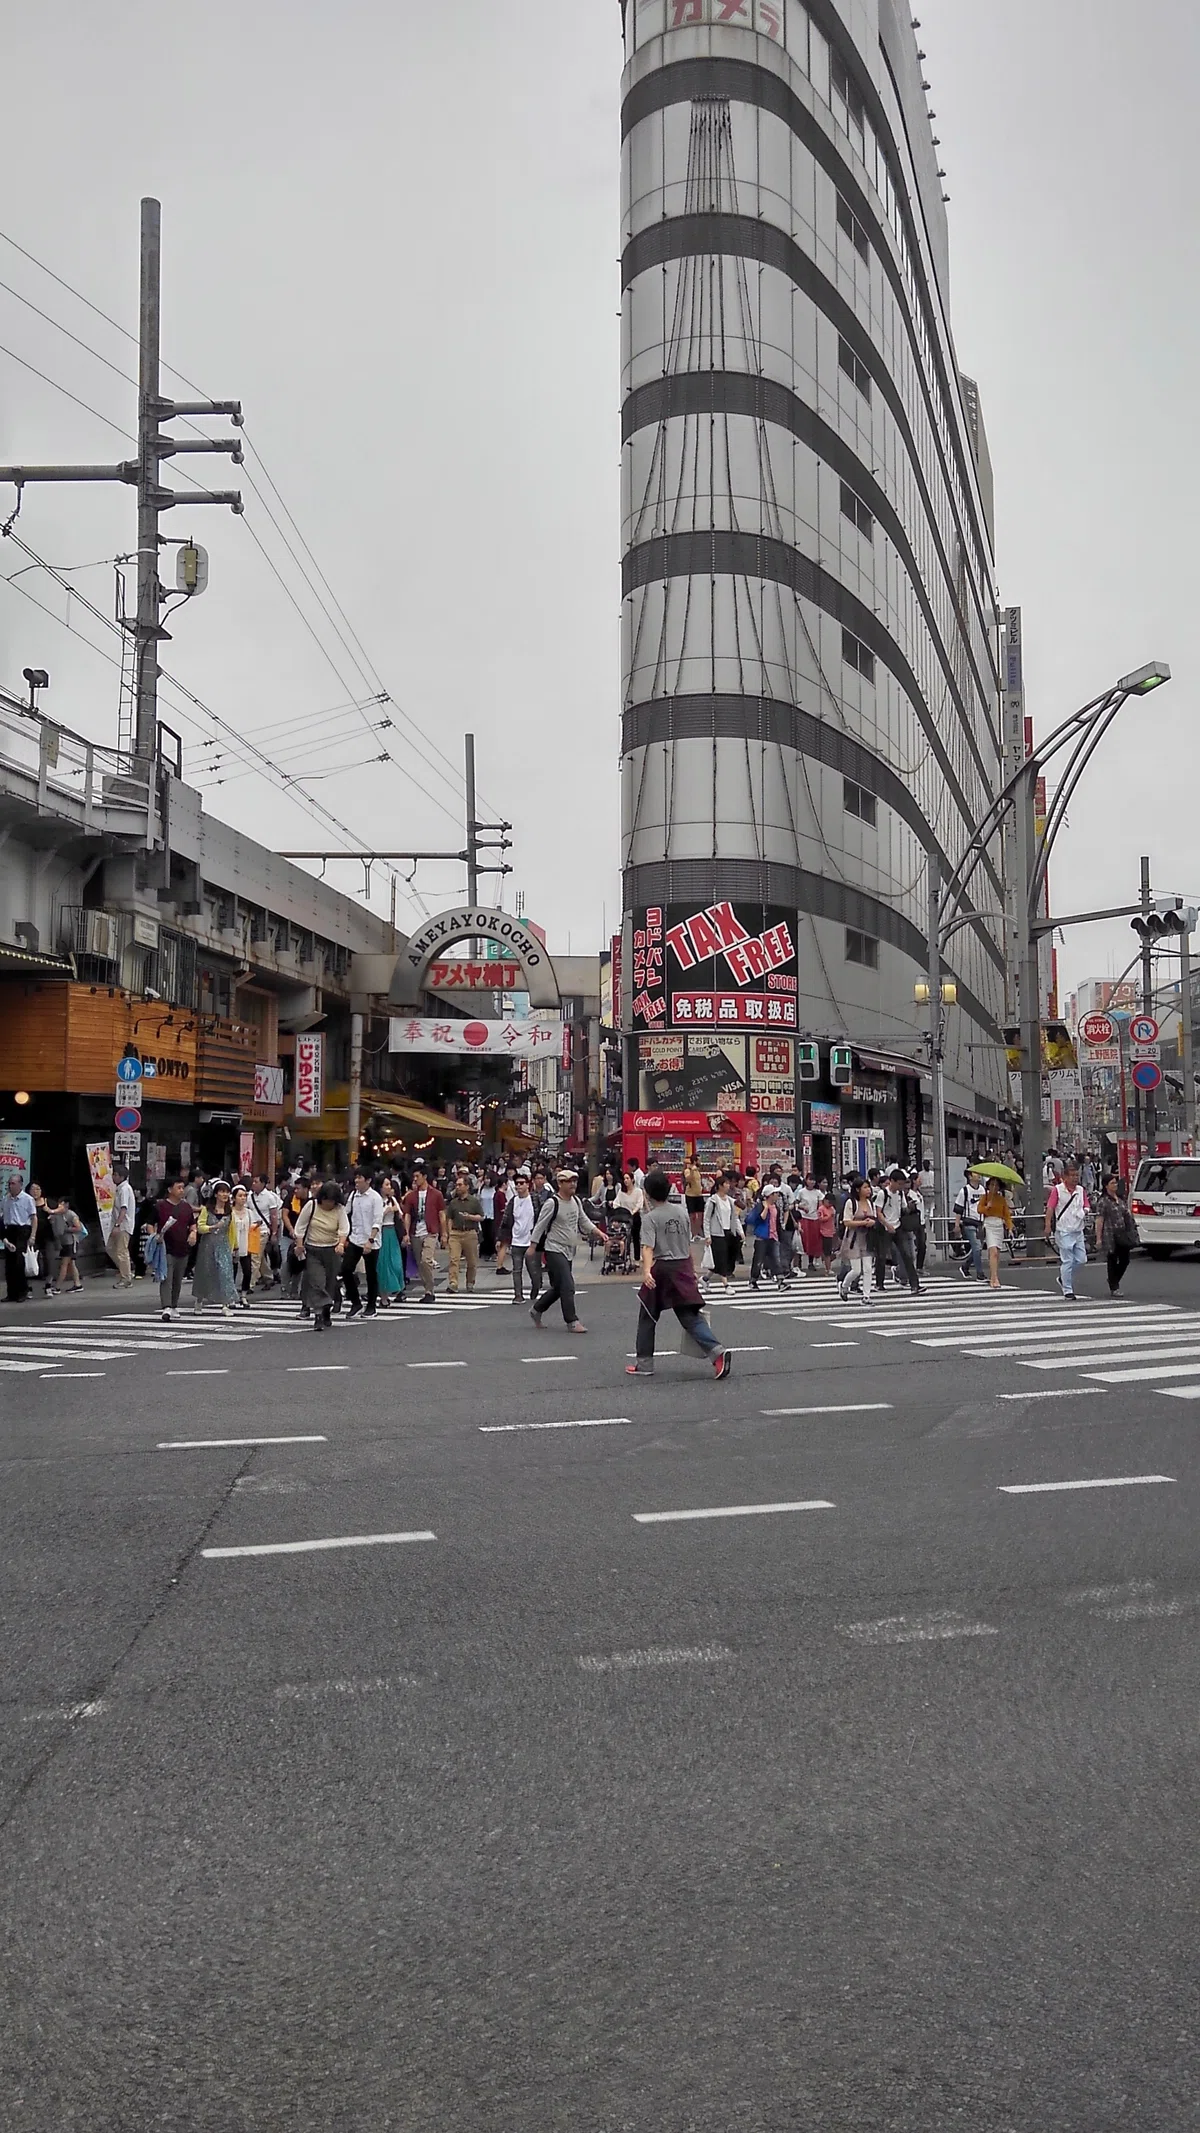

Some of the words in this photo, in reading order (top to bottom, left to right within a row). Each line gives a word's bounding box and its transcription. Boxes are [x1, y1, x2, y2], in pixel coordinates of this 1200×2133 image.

[408, 914, 540, 967] AMEYAYOKOCHO
[646, 907, 662, 988] ヨドバシ
[666, 901, 751, 971] TAX
[723, 920, 796, 987] FREE
[634, 929, 646, 989] カメラ
[430, 963, 521, 988] アメヤ横丁
[768, 973, 797, 992] STORE
[632, 990, 651, 1017] TAX
[642, 996, 667, 1023] FREE
[676, 997, 795, 1022] 免税品取扱店
[402, 1019, 455, 1044] 奉祝
[501, 1022, 553, 1047] 令和
[1086, 1023, 1110, 1035] 消火栓
[298, 1043, 313, 1114] じゅらく
[721, 1080, 744, 1093] VISA
[1051, 1069, 1078, 1080] クリムト
